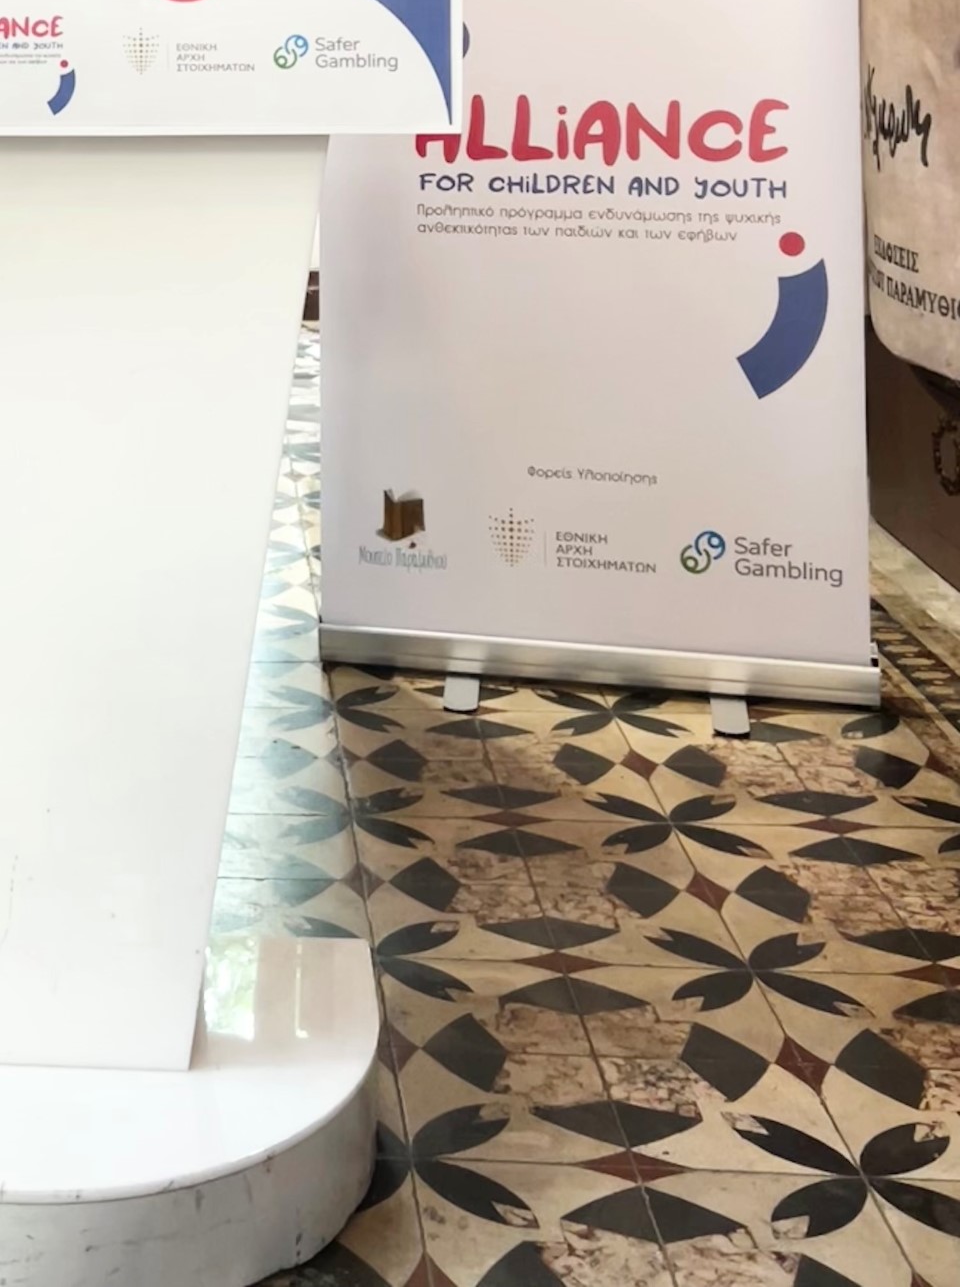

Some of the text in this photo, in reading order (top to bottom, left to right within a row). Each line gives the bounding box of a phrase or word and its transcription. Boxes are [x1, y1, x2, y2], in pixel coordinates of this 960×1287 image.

[175, 42, 218, 52] ΕΘΝΙΚΗ
[314, 36, 361, 52] Safer
[175, 53, 206, 62] ΑΡΧΗ
[314, 53, 399, 72] Gambling
[418, 172, 475, 193] FOR
[627, 176, 681, 198] AND
[693, 176, 788, 200] YOUTH
[416, 203, 782, 225] Προληπτικό πρόγραμμα ενδυνάμωσης της ψυχικής
[416, 221, 738, 243] ανθεκτικότητας των παιδιών και των εφήβων
[886, 275, 960, 320] ΠΑΡΑΜΥΘΙ
[526, 465, 659, 486] Φορείς Υλοποίησης
[554, 530, 609, 545] ΕΘΝΙΚΗ
[733, 536, 793, 557] Safer
[554, 543, 594, 556] ΑΡΧΗ
[555, 555, 657, 574] ΣΤΟΙΧΗΜΑΤΩΝ
[734, 557, 844, 589] Gambling
